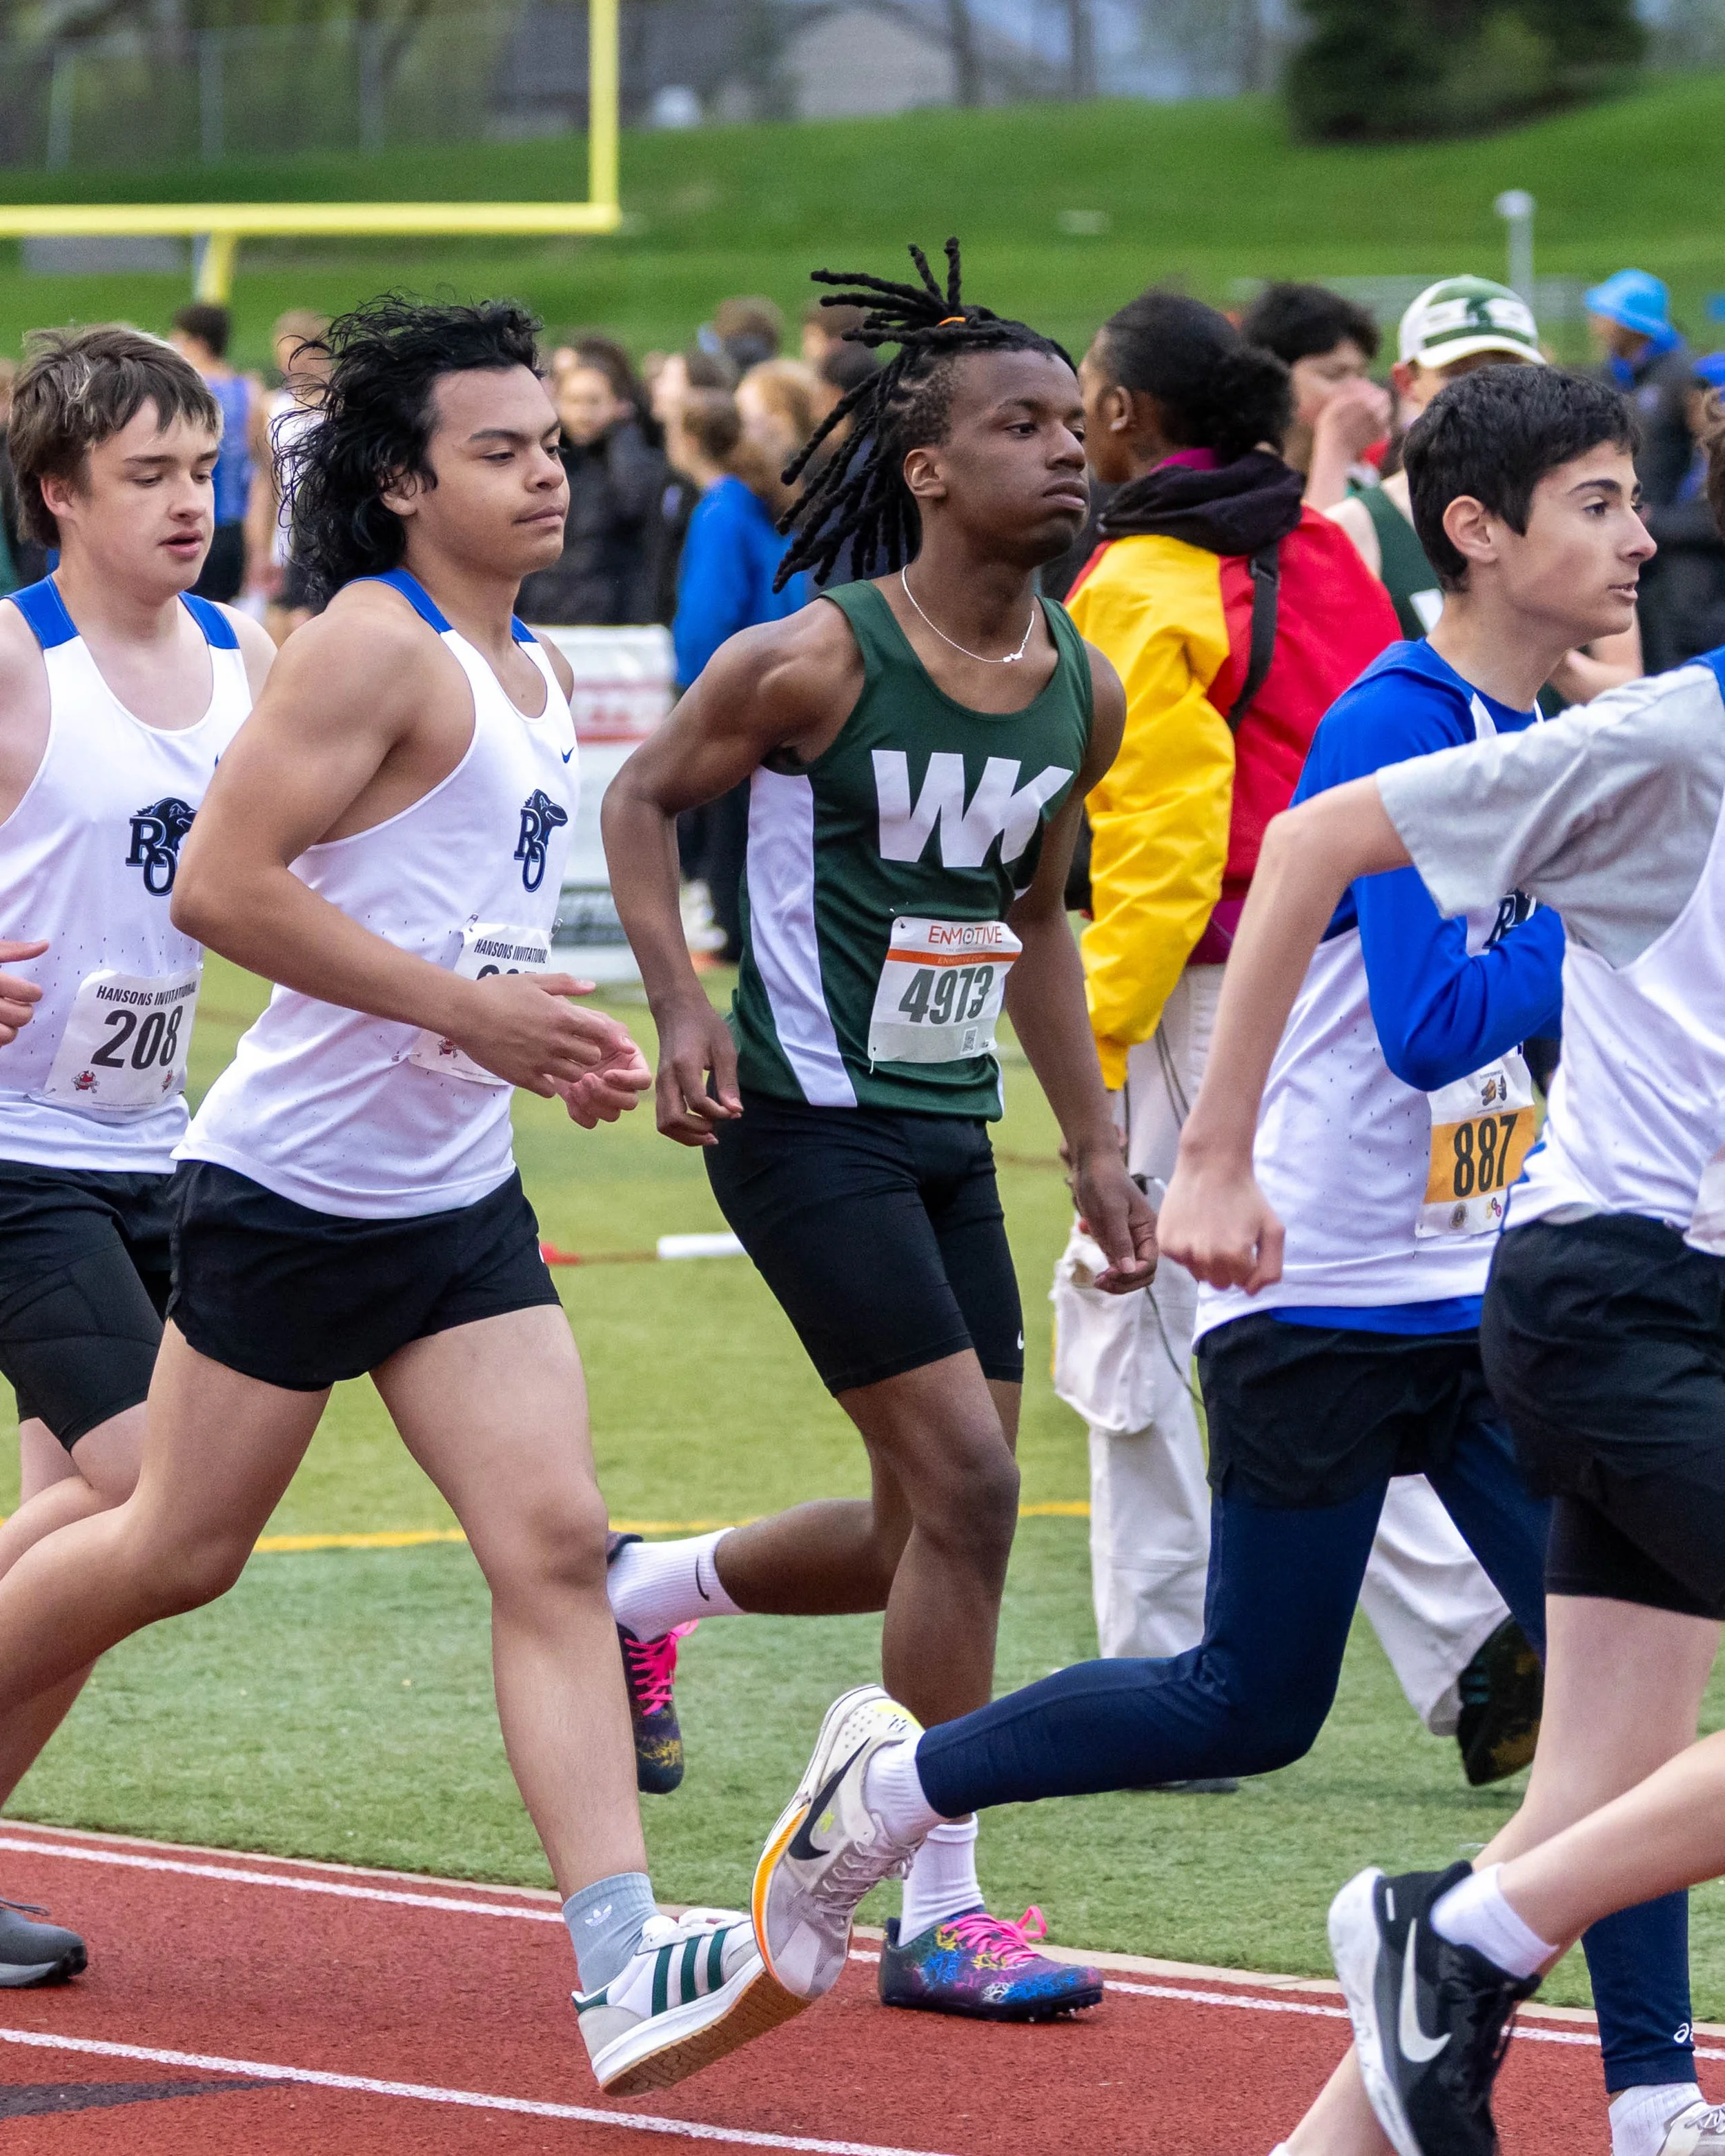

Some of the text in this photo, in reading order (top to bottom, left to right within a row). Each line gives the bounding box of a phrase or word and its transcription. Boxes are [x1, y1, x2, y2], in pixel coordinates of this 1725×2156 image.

[871, 749, 1074, 868] WK
[473, 938, 513, 960] HANSONS
[96, 985, 152, 1006] HANSONS
[90, 1005, 183, 1070] 208
[1454, 1114, 1518, 1198] 887
